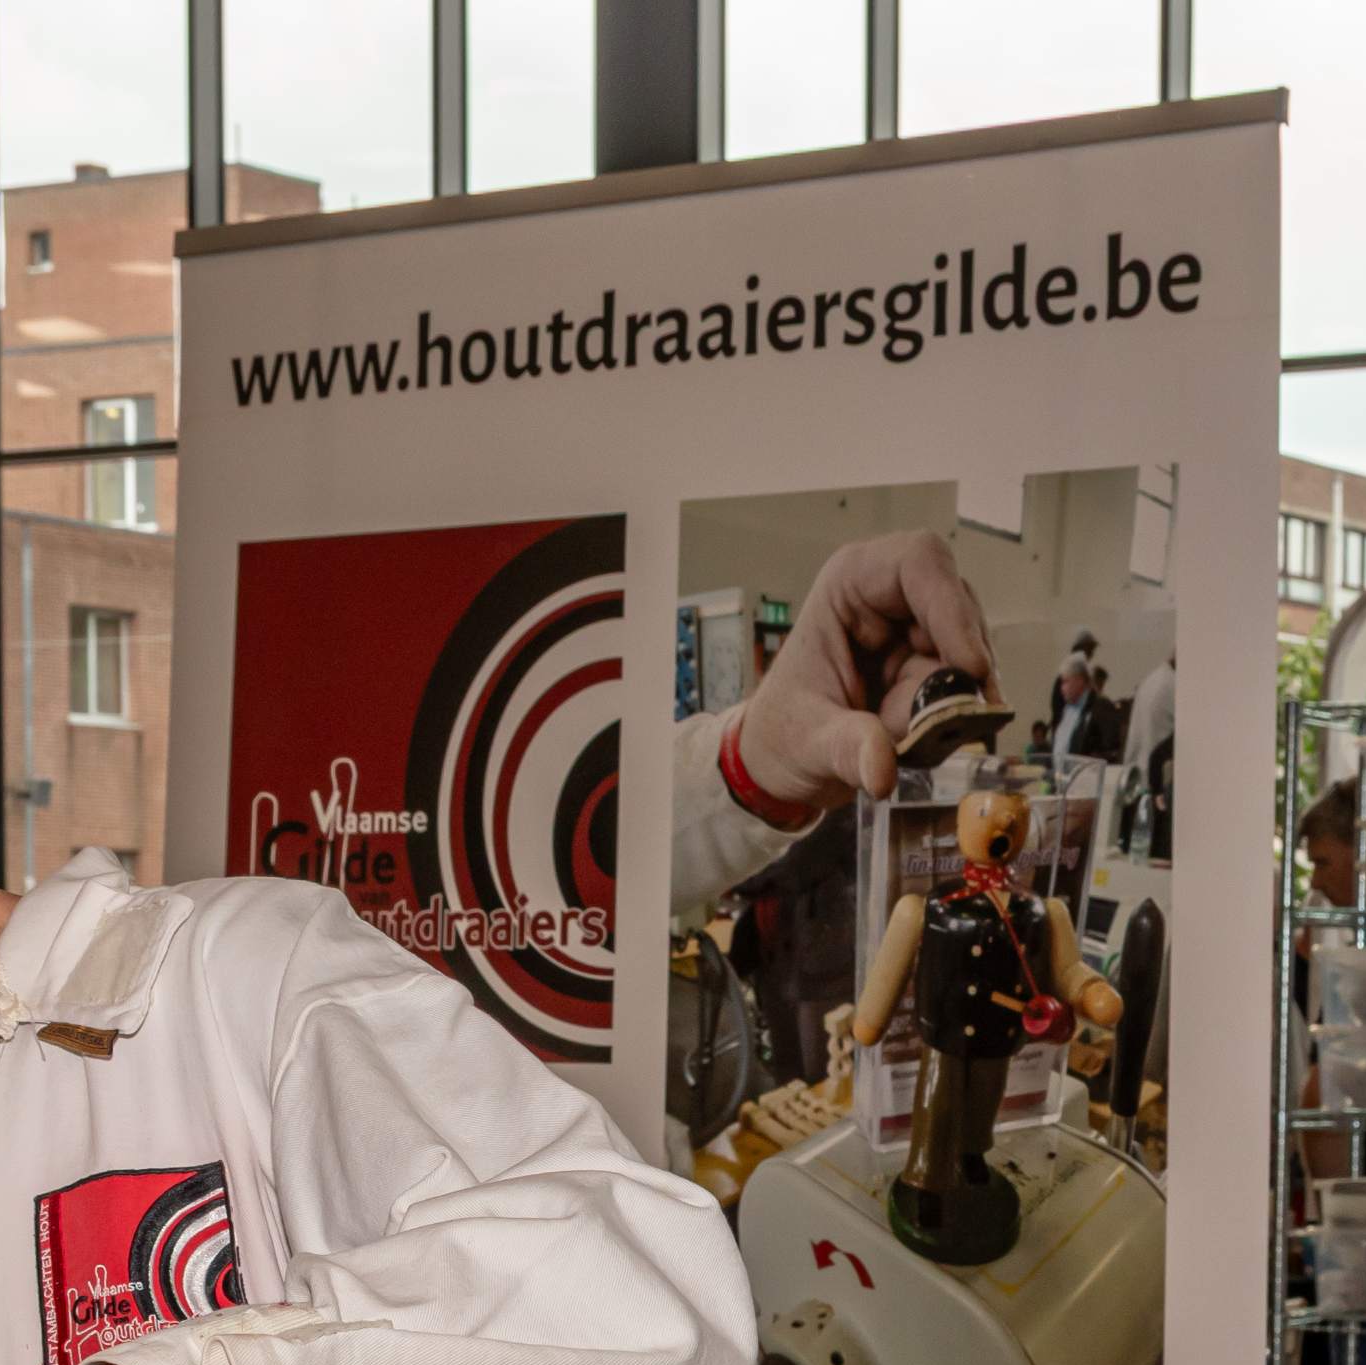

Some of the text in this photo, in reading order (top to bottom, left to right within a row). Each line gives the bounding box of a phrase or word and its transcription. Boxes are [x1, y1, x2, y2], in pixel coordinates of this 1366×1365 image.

[230, 232, 1203, 408] www.houtdraaiersgilde.be
[310, 789, 429, 835] Vlaamse
[39, 1202, 51, 1245] HOUT
[72, 1295, 131, 1325] Gilde
[88, 1280, 144, 1298] Vlaamse
